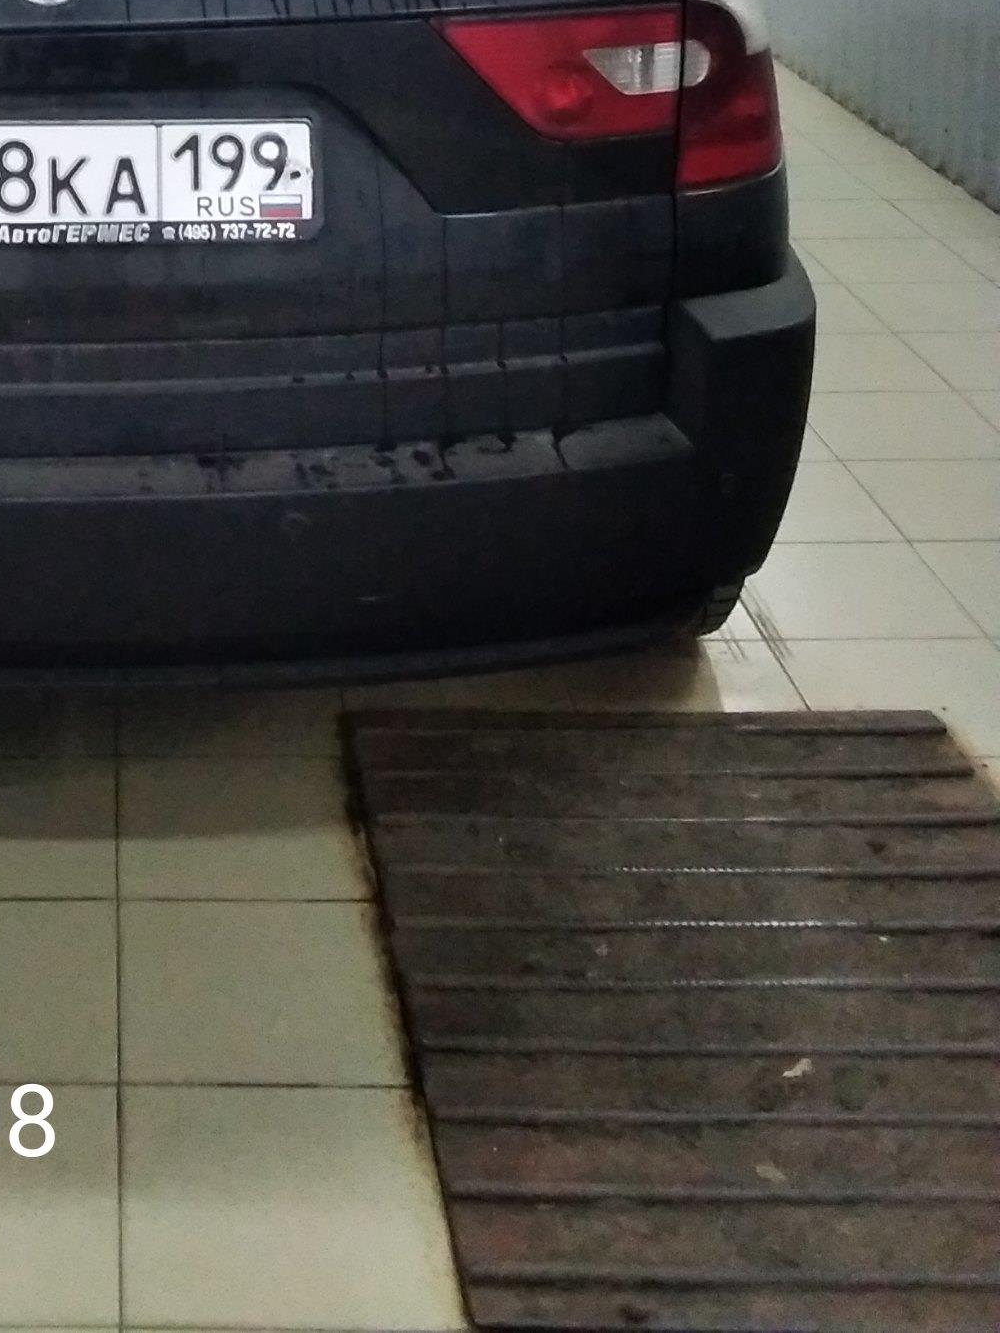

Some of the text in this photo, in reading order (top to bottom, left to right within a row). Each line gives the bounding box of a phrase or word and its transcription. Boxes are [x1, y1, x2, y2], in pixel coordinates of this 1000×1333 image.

[172, 134, 287, 191] 199
[196, 197, 255, 217] RUS
[178, 223, 296, 241] (495) 737-72-72
